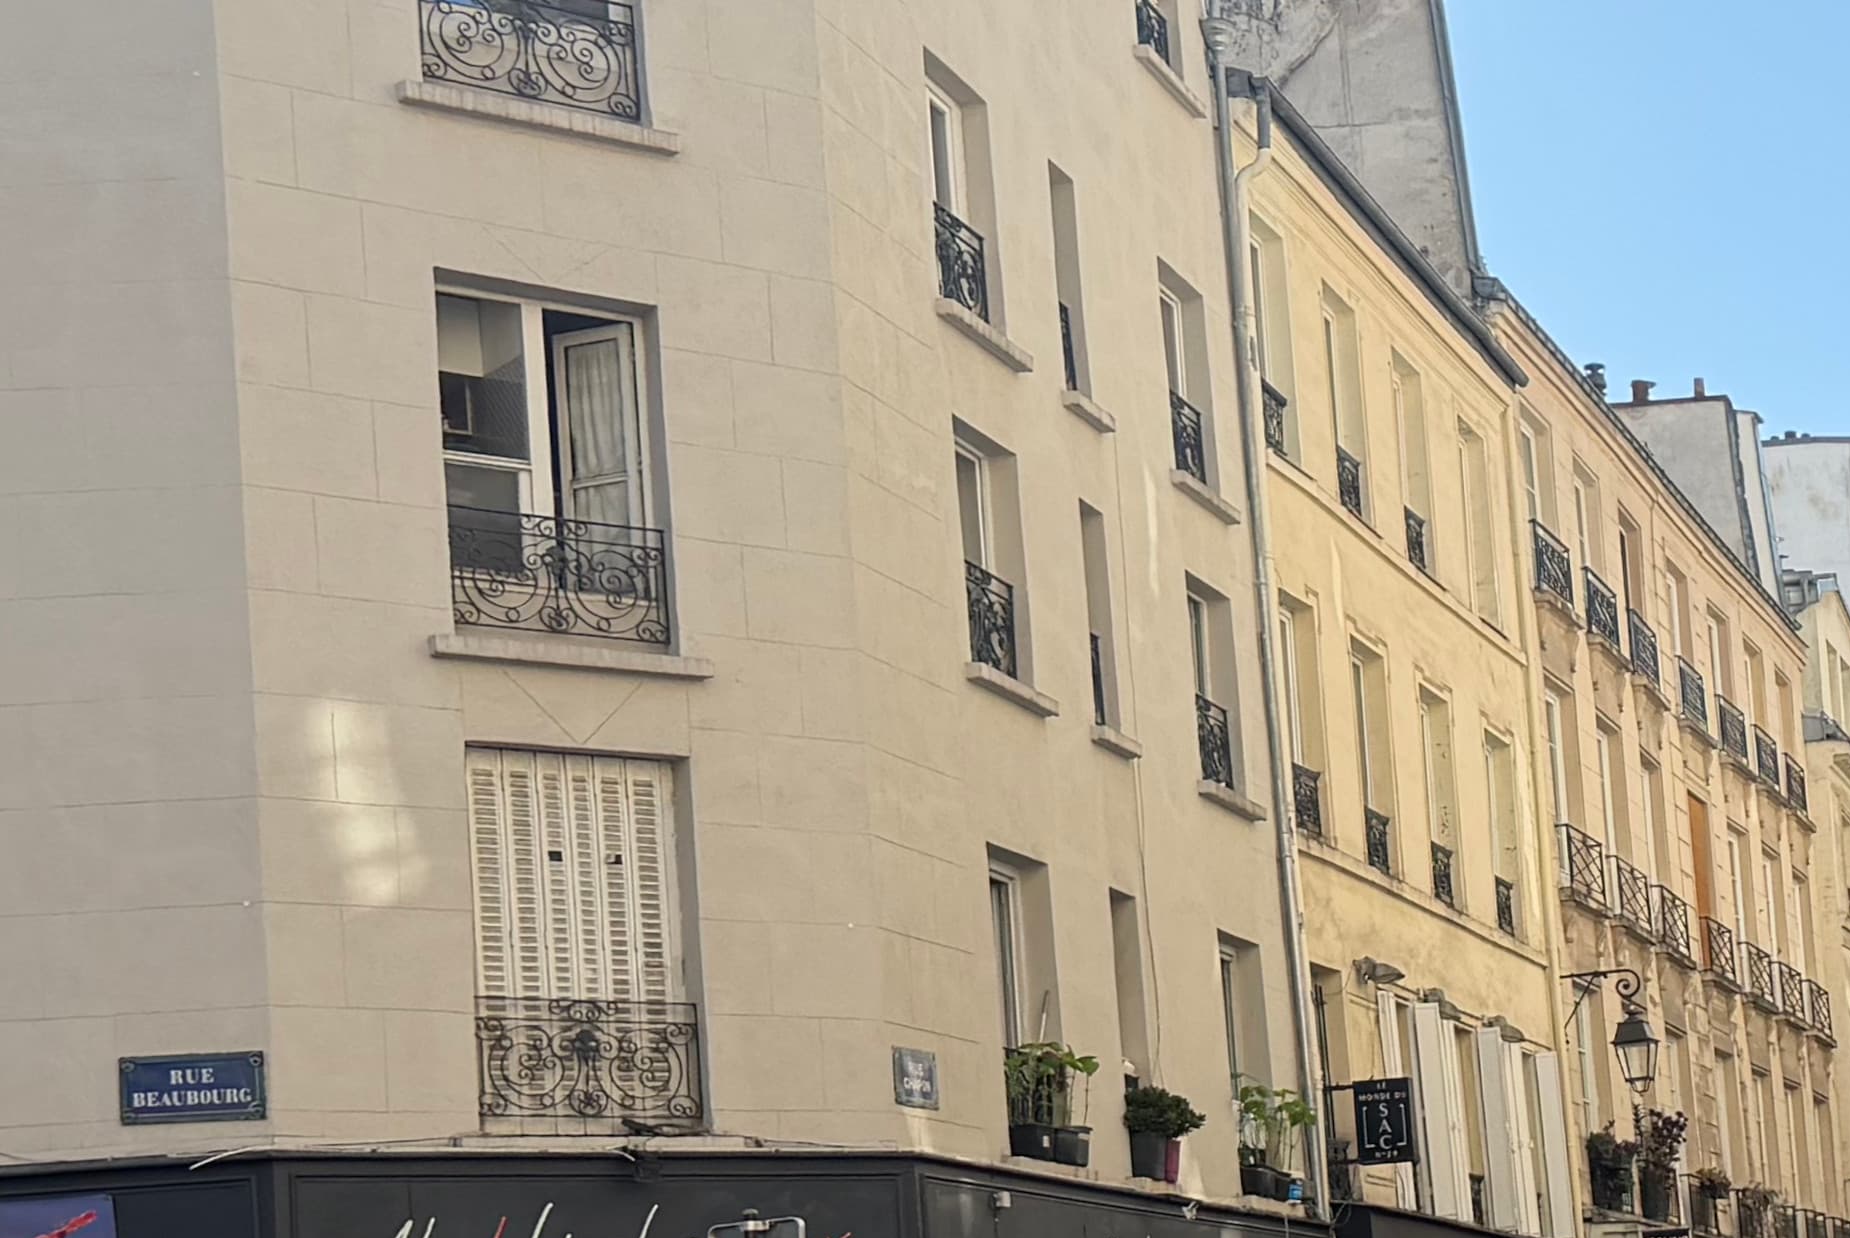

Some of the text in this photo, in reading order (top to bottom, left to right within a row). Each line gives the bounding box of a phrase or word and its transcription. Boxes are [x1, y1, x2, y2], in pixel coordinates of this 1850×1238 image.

[169, 1067, 215, 1085] RUE
[132, 1087, 252, 1108] BEAUBOURG
[1378, 1102, 1393, 1150] SAC
